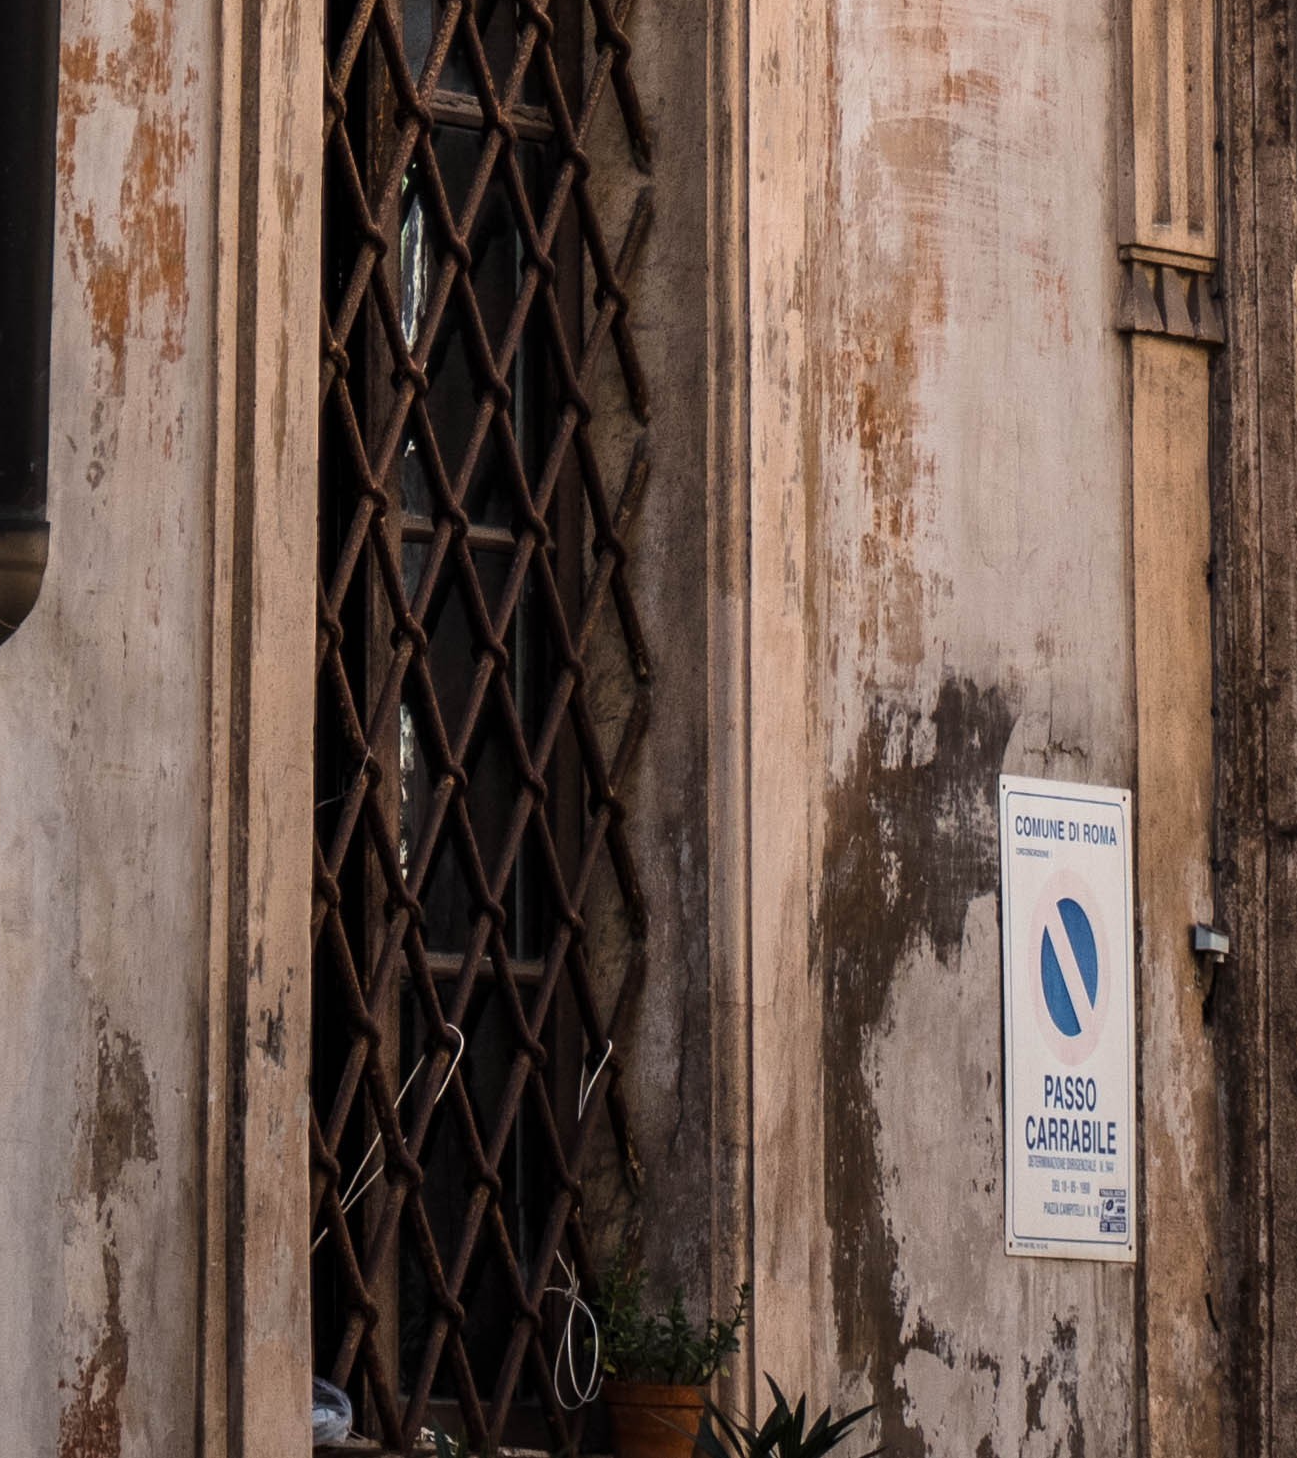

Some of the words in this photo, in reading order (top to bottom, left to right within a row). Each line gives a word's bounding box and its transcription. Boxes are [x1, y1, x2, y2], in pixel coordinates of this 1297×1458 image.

[1015, 815, 1065, 841] COMUNE
[1068, 821, 1079, 842] DI
[1084, 823, 1117, 846] ROMA
[1044, 1075, 1097, 1112] PASSO
[1025, 1115, 1116, 1155] CARRABILE
